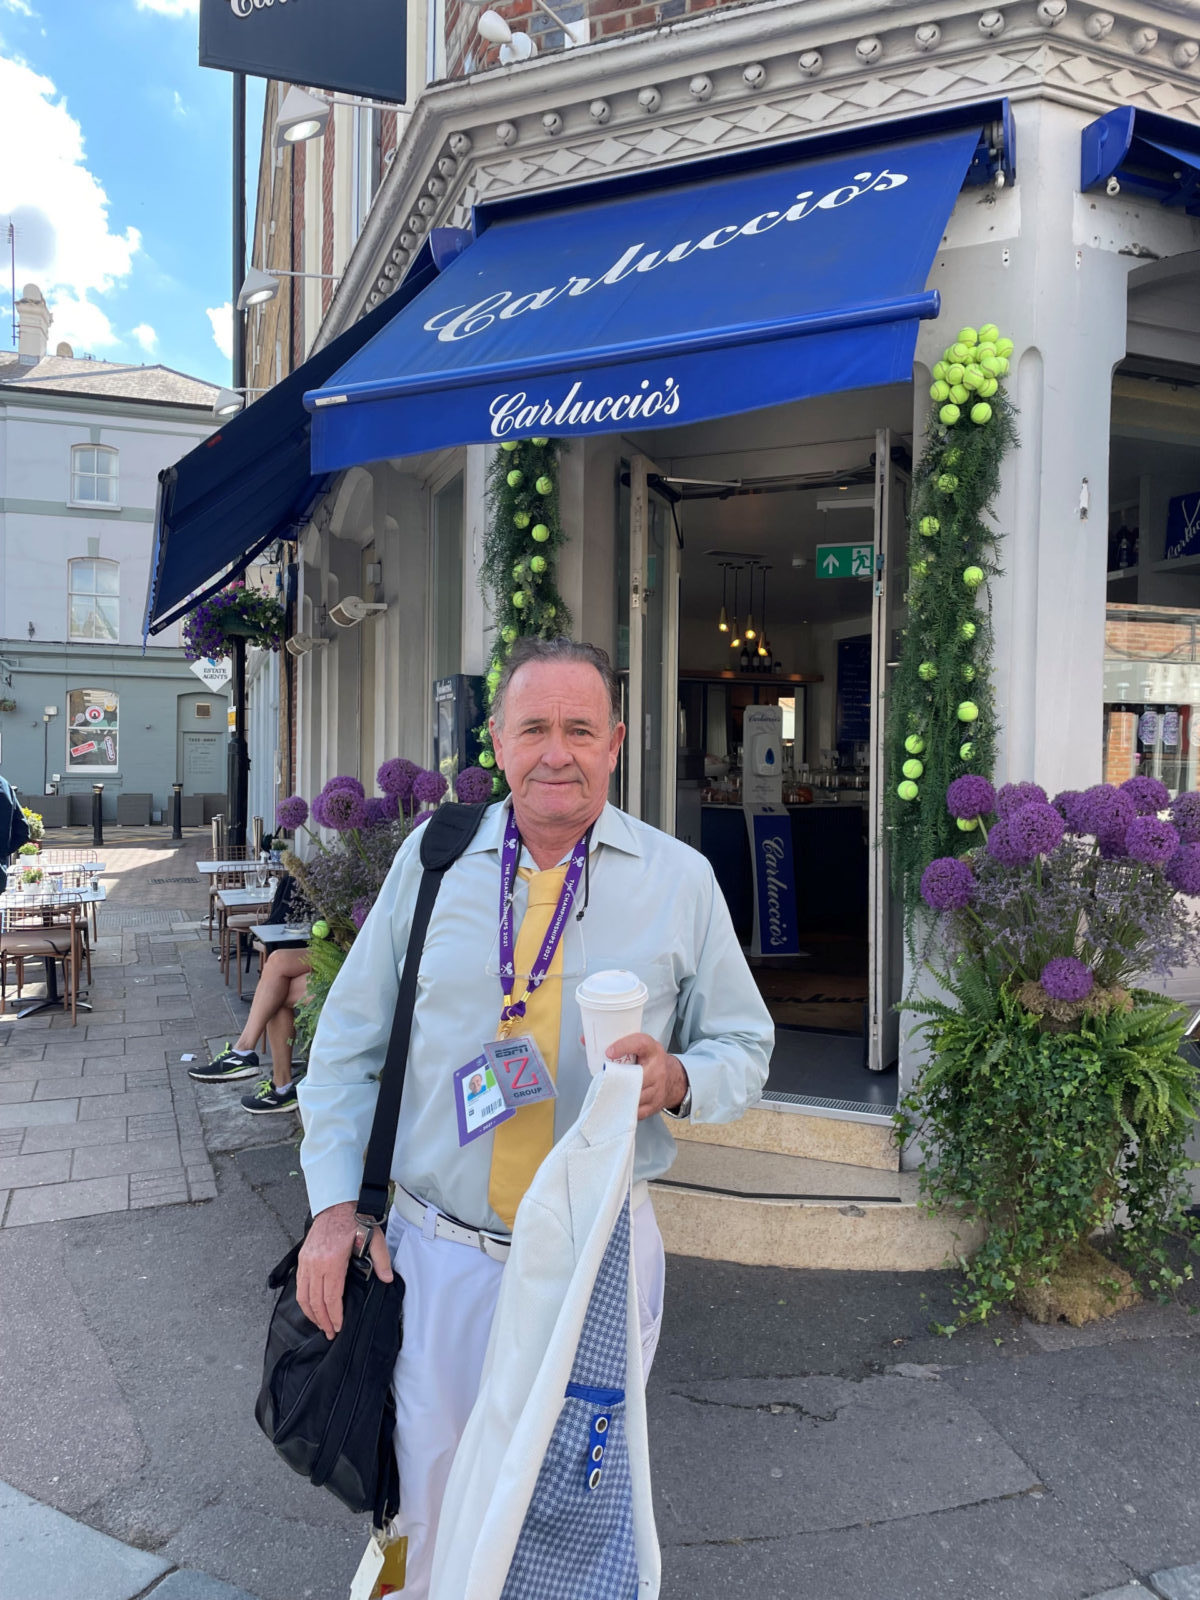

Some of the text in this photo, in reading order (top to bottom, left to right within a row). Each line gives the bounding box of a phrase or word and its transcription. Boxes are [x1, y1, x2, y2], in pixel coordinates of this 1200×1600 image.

[423, 168, 909, 342] Carluccio's
[489, 376, 681, 438] Carluccio's
[542, 879, 575, 961] THE CHAMPIONSHIPS 2021
[761, 836, 789, 947] Carluccio's
[495, 1044, 529, 1059] ESPN
[504, 1056, 539, 1089] Z
[513, 1086, 543, 1098] GROUP
